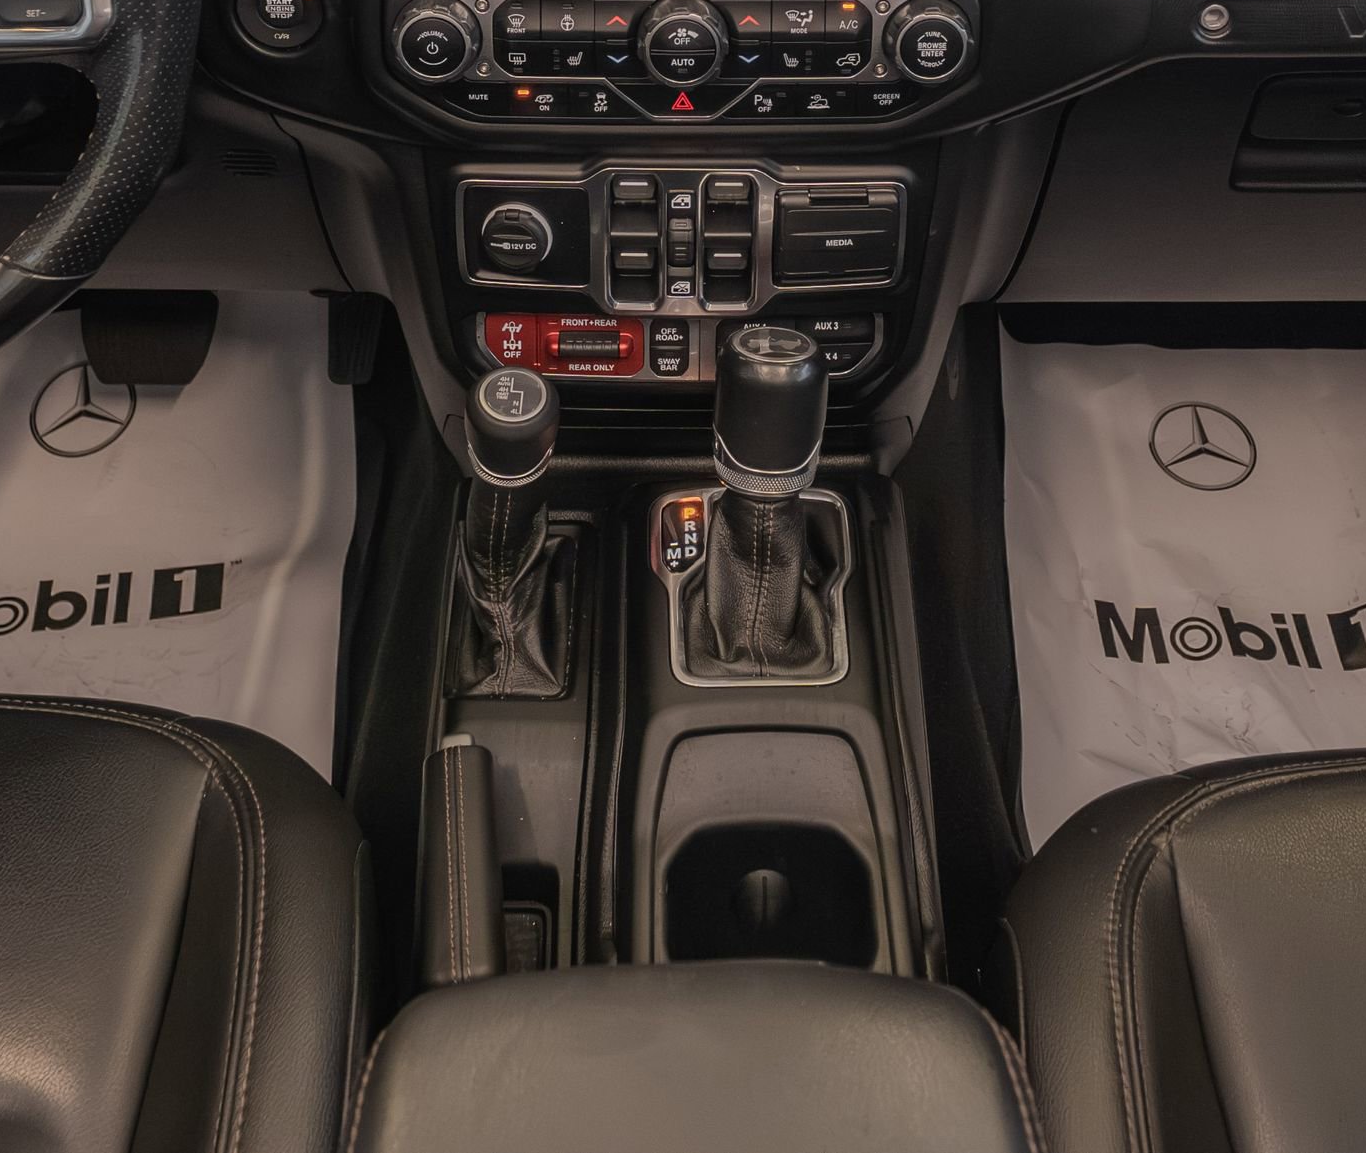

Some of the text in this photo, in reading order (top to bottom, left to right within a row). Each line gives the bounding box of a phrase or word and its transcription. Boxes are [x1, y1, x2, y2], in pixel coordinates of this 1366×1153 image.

[266, 5, 296, 13] ENGINE
[839, 20, 859, 30] A/C
[418, 30, 445, 40] VOLUME
[674, 37, 691, 46] OFF
[670, 58, 695, 66] AUTO
[920, 59, 943, 68] SCROLL
[825, 238, 854, 247] MEDIA
[561, 319, 617, 327] FRONT+REAR
[814, 322, 839, 330] AUX 3
[684, 507, 695, 518] P
[685, 520, 696, 531] R
[685, 533, 697, 544] N
[667, 548, 681, 560] M
[685, 547, 697, 557] D
[1094, 599, 1323, 670] Mobil
